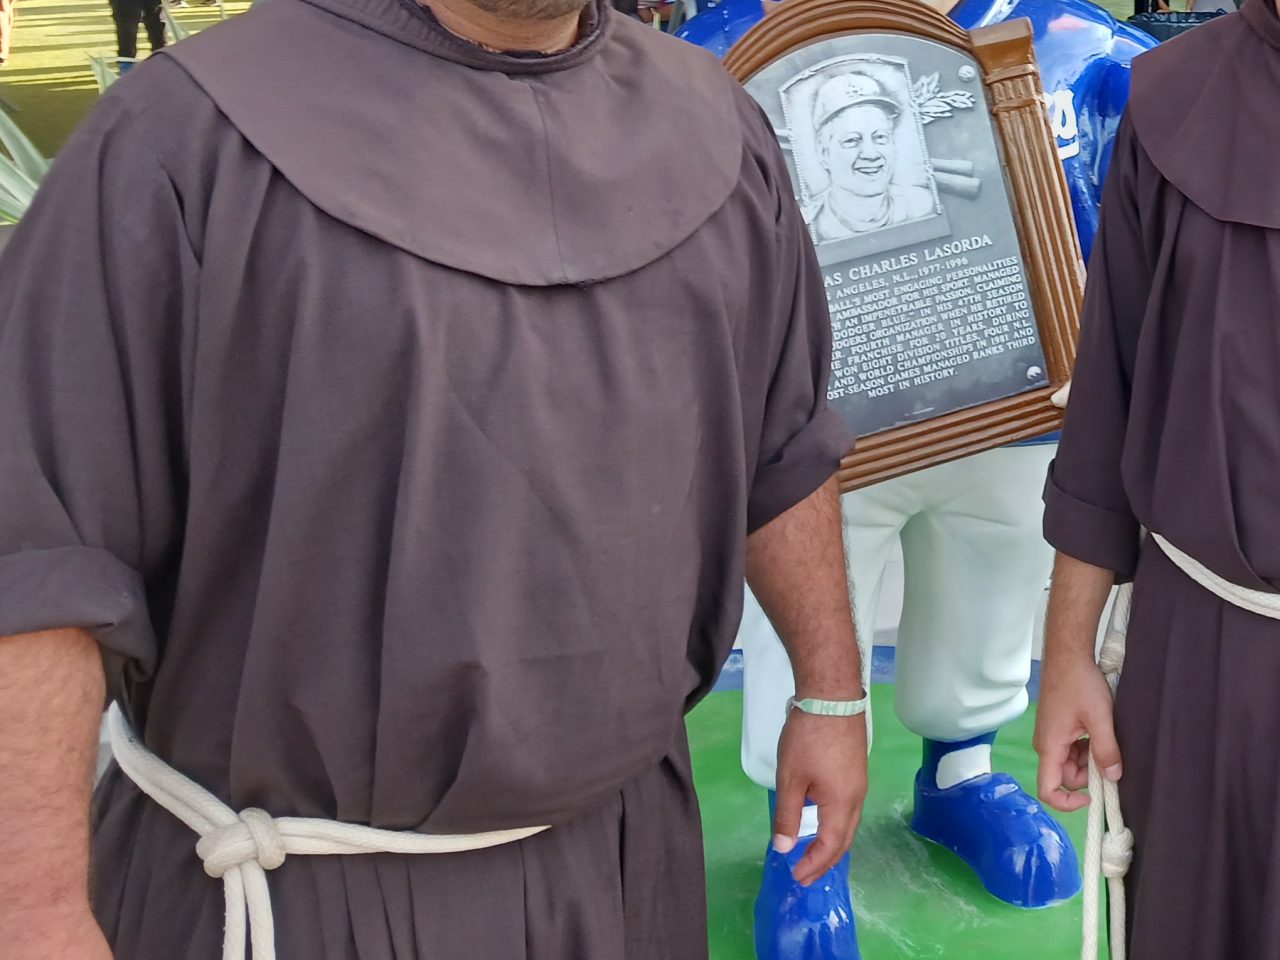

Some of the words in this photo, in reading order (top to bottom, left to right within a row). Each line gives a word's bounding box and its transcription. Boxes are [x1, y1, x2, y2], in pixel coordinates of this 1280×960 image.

[836, 278, 890, 299] ANGELES,
[919, 256, 969, 277] 1977-1996
[848, 252, 919, 280] CHARLES
[923, 234, 993, 261] LASORDA
[863, 289, 890, 304] MOST
[893, 276, 943, 296] ENGAGING
[946, 256, 1018, 281] PERSONALITIES
[833, 322, 876, 340] DODGER
[920, 307, 932, 317] IN
[936, 301, 953, 313] HIS
[957, 294, 982, 306] 47TH
[986, 282, 1024, 299] SEASON
[836, 297, 899, 321] AMBASSADOR
[901, 291, 920, 303] FOR
[922, 287, 938, 298] HIS
[973, 265, 1020, 283] MANAGED
[844, 317, 859, 328] AN
[861, 297, 933, 324] IMPENETRABLE
[976, 274, 1022, 292] CLAIMING
[869, 315, 938, 340] ORGANIZATION
[940, 307, 968, 321] WHEN
[970, 302, 985, 313] HE
[986, 292, 1025, 309] RETIRED
[833, 365, 858, 378] WON
[862, 355, 894, 371] EIGHT
[897, 343, 941, 362] DIVISION
[984, 324, 1010, 338] FOUR
[847, 343, 905, 366] FRANCHISE
[910, 336, 930, 349] FOR
[935, 331, 947, 342] 20
[992, 309, 1030, 327] DURING
[850, 337, 891, 355] FOURTH
[896, 323, 945, 343] MANAGER
[950, 318, 962, 328] IN
[966, 306, 1008, 323] HISTORY
[1013, 300, 1028, 311] TO
[834, 376, 855, 389] AND
[858, 365, 895, 381] WORLD
[897, 343, 974, 371] CHAMPIONSHIPS
[976, 340, 988, 350] IN
[990, 333, 1009, 346] 1981
[1013, 327, 1034, 340] AND
[887, 367, 921, 383] GAMES
[923, 354, 970, 374] MANAGED
[972, 345, 1004, 360] RANKS
[1006, 336, 1036, 351] THIRD
[867, 384, 896, 399] MOST
[899, 379, 911, 390] IN
